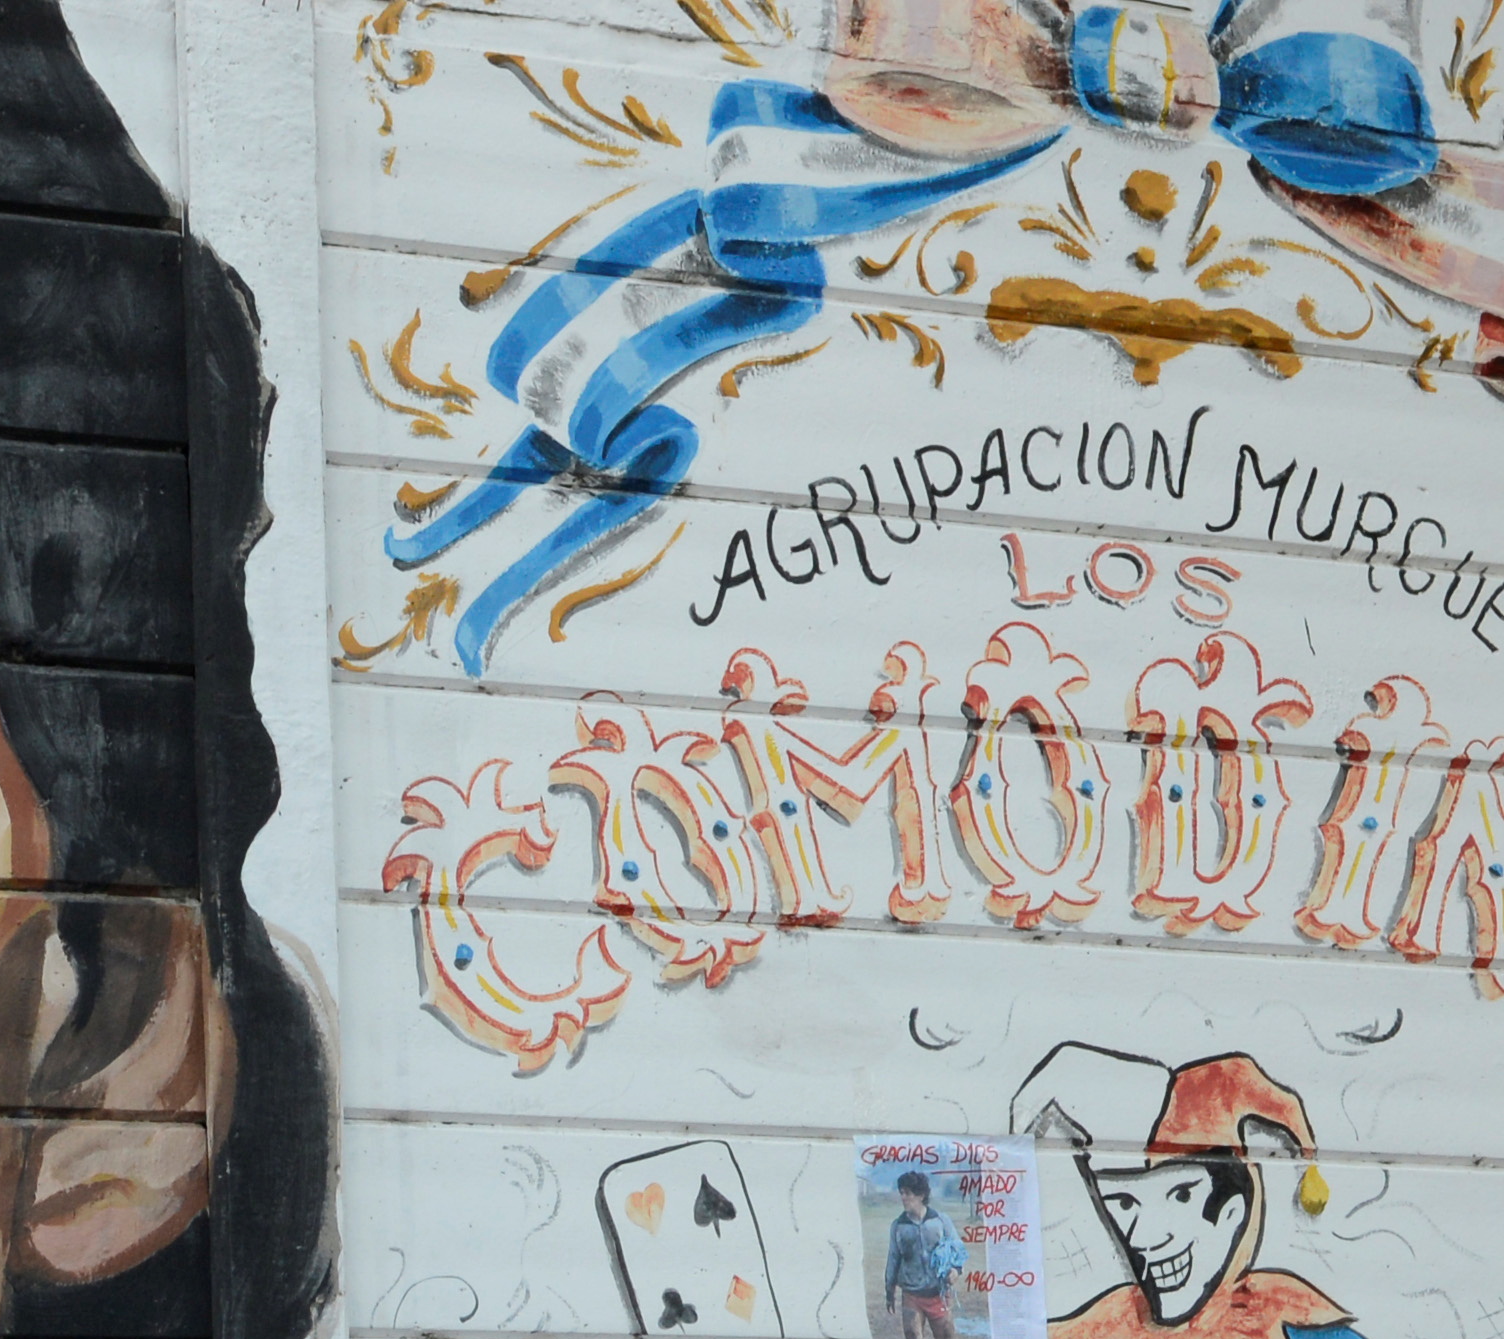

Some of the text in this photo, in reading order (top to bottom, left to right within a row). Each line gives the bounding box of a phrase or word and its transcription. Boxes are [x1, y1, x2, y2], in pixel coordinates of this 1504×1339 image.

[690, 405, 1211, 626] AGRUPACION
[1001, 531, 1242, 623] LOS
[959, 1175, 1017, 1197] AMADO
[975, 1200, 1005, 1218] POR
[962, 1224, 1029, 1243] SIEMPRE
